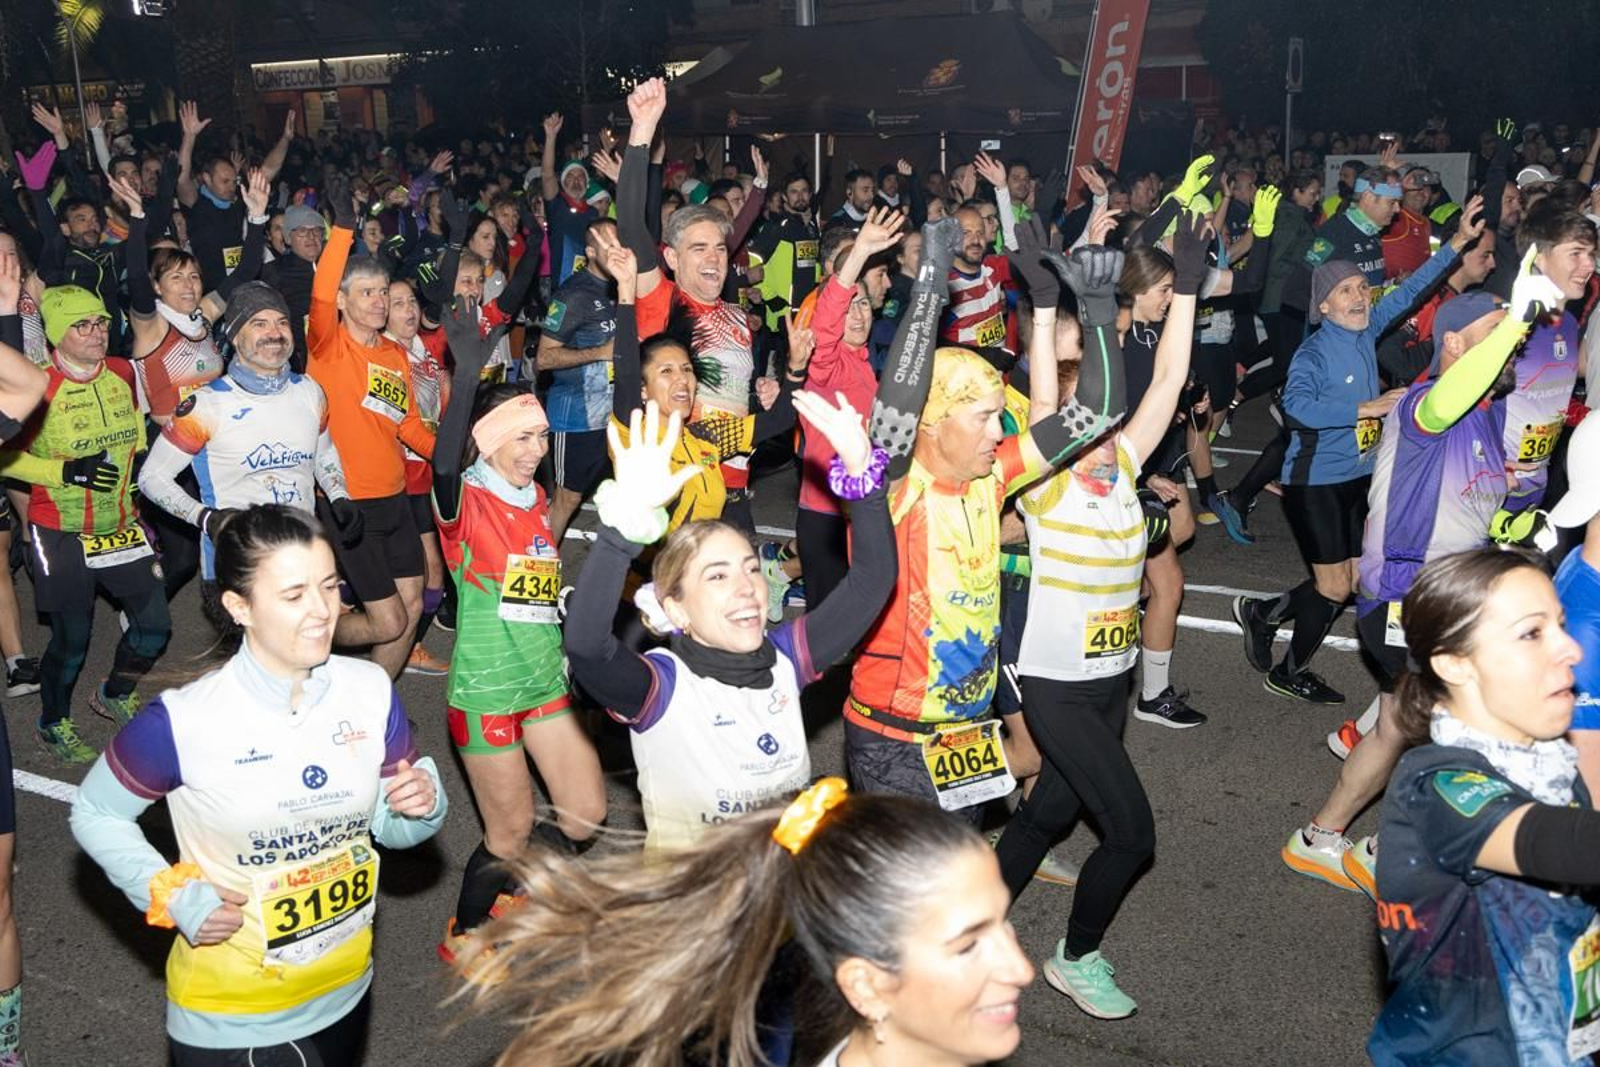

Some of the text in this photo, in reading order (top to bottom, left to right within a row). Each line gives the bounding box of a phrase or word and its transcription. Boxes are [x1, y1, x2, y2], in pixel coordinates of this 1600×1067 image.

[894, 321, 922, 384] WEEKEND
[373, 377, 407, 406] 3657
[87, 528, 141, 551] 3192
[934, 742, 999, 781] 4064
[278, 797, 307, 809] PABLO
[310, 789, 355, 803] CARVAJAL
[716, 788, 753, 801] CLUB
[248, 826, 288, 841] CLUB
[294, 819, 311, 832] DE
[252, 830, 320, 851] SANTA
[345, 818, 369, 832] DE
[237, 851, 277, 866] LOS
[286, 867, 311, 888] 42
[273, 869, 369, 933] 3198
